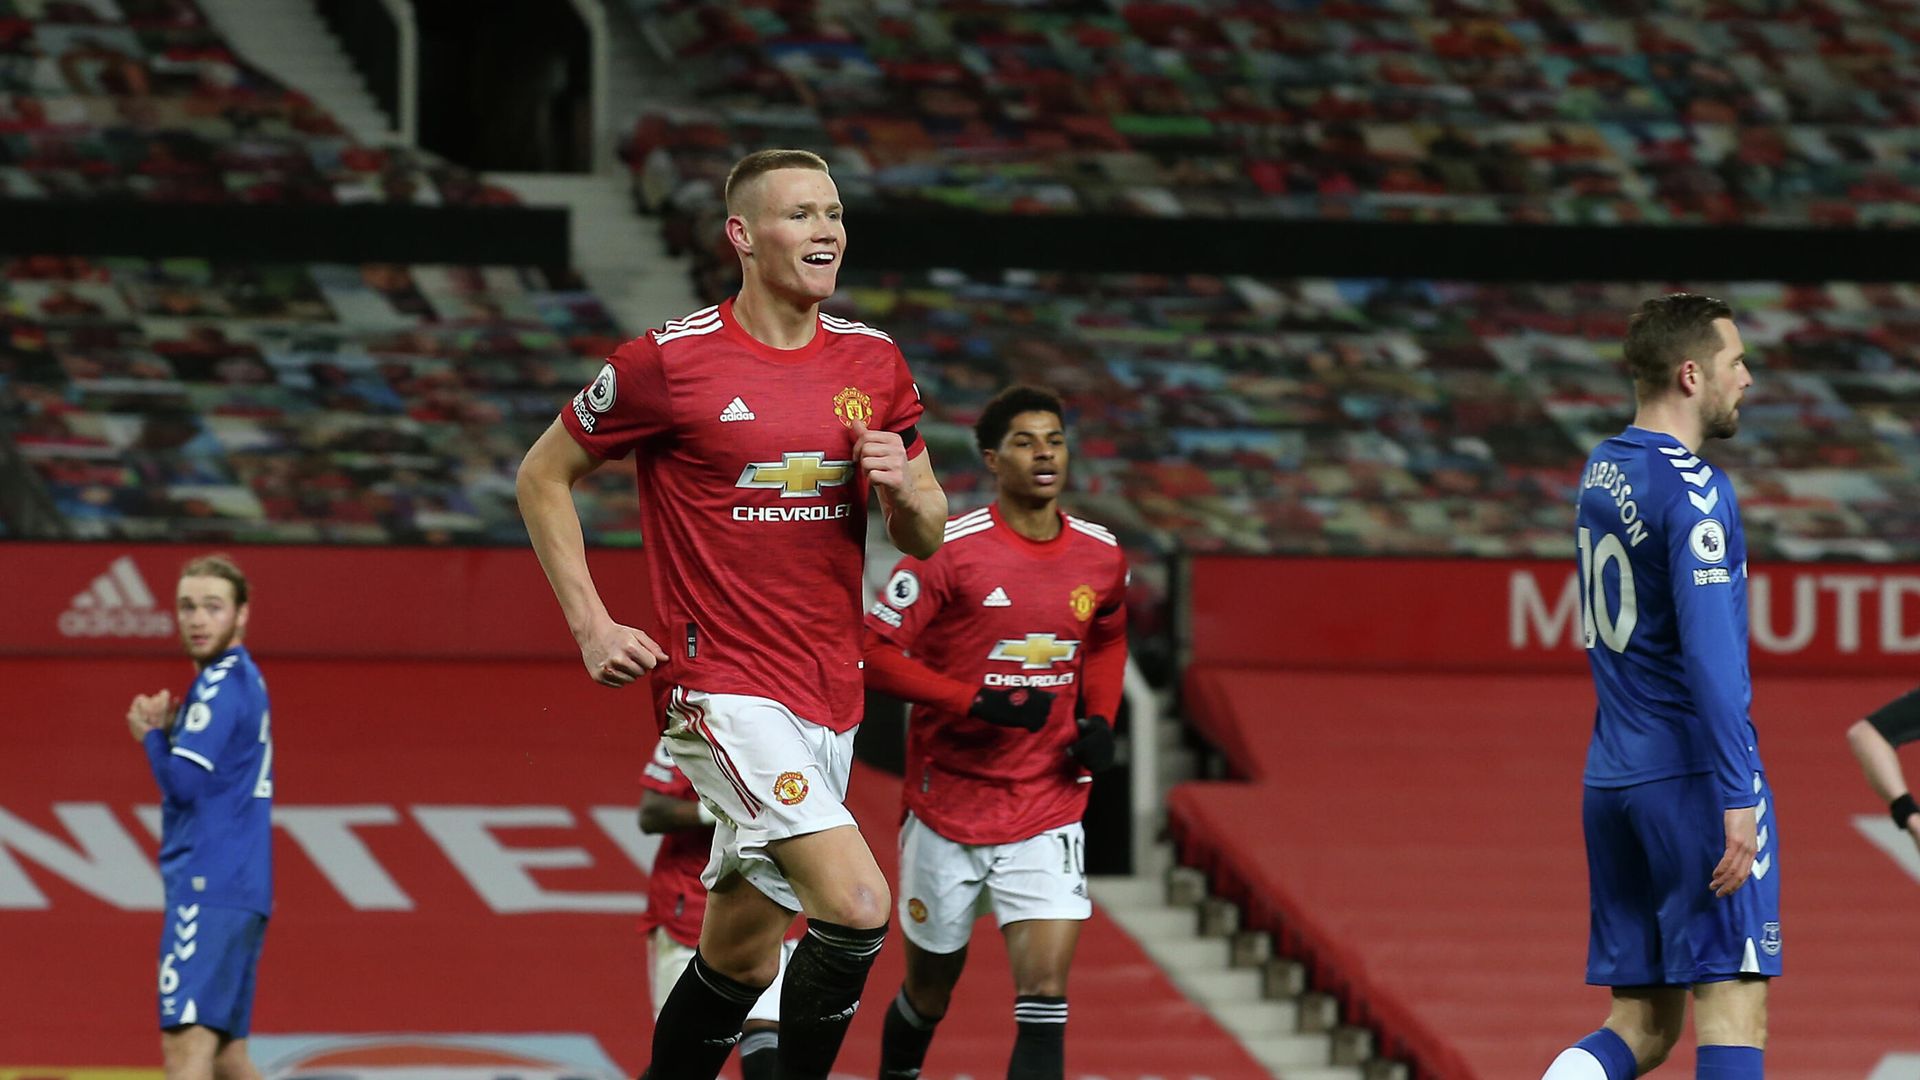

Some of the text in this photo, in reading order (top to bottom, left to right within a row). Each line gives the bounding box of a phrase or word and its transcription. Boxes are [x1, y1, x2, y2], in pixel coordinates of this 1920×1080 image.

[719, 410, 755, 422] adidas
[1584, 461, 1649, 547] URDSSON
[1578, 526, 1638, 654] 10
[58, 609, 174, 637] adidas
[984, 672, 1075, 688] CHEVROLET
